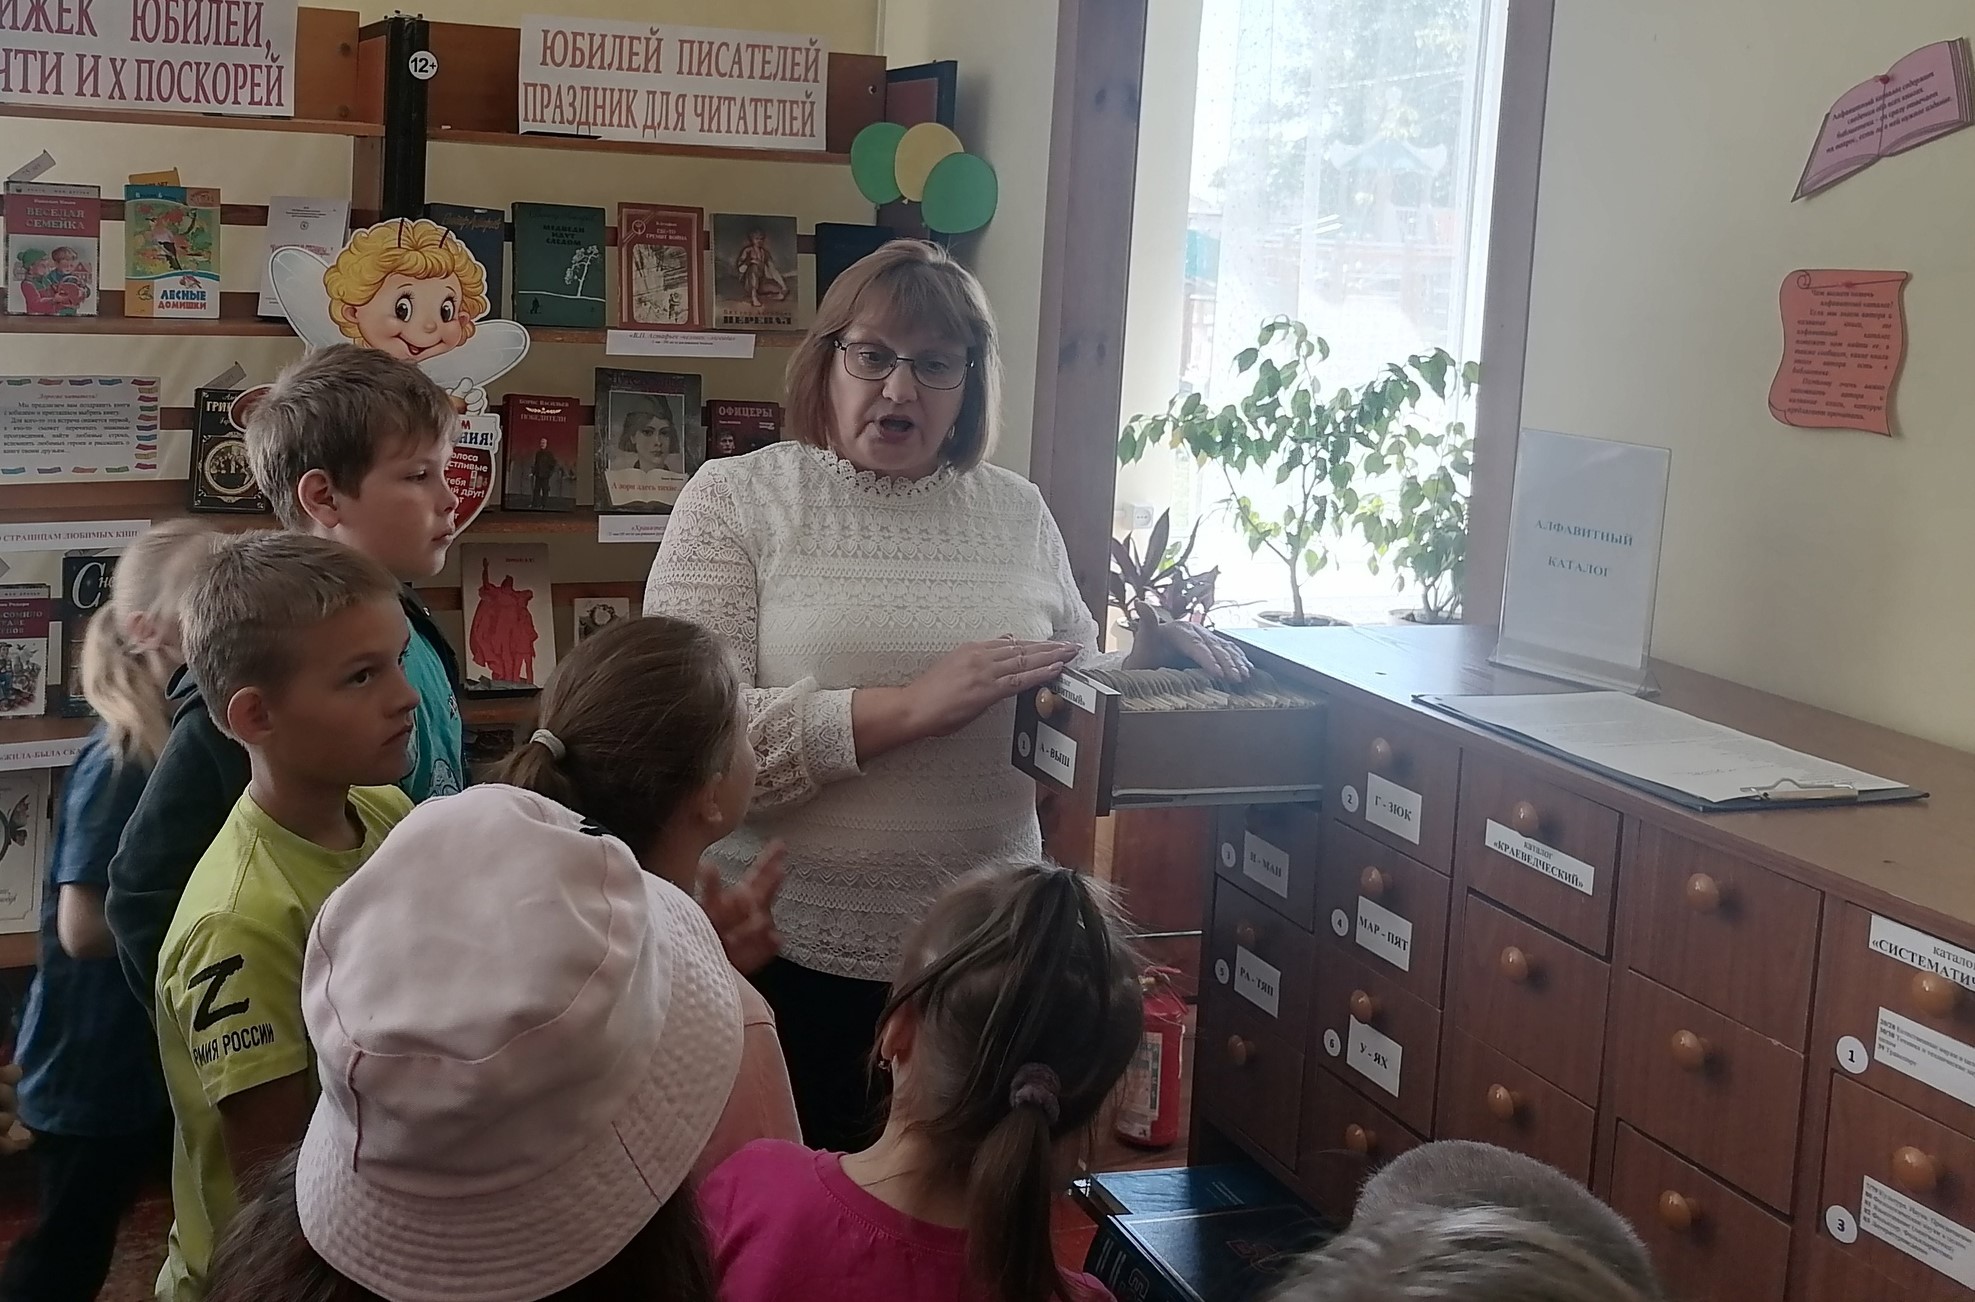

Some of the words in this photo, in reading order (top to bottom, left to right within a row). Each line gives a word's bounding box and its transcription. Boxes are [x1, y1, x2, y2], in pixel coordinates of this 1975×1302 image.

[0, 0, 98, 37] ИЖЕК
[540, 27, 662, 75] ЮБИЛЕЙ
[677, 37, 820, 85] ПИСАТЕЛЕЙ
[410, 57, 437, 73] 12+
[0, 48, 64, 96] ЧТИ
[135, 54, 285, 107] ПОСКОРЕЙ
[522, 82, 638, 135] ПРАЗДНИК
[642, 88, 687, 140] ДЛЯ
[693, 91, 816, 138] ЧИТАТЕЛЕЙ
[161, 290, 206, 301] ЛЕСНЫЕ
[158, 301, 206, 310] ДОМИШКИ
[723, 316, 792, 325] ПЕРЕВАЛ
[719, 406, 773, 419] ОФИЦЕРЫ
[458, 431, 494, 446] НИЯ!
[449, 461, 488, 472] стливые
[4, 533, 61, 542] СТРАНИЦАМ
[63, 531, 113, 540] ЛЮБИМЫХ
[1534, 519, 1633, 546] АЛФАВИТНЫЙ
[1548, 556, 1609, 577] КАТАЛОГ
[63, 747, 80, 755] СКА
[1050, 748, 1070, 767] ВЫШ
[1347, 794, 1352, 804] 2
[1375, 795, 1382, 807] Г
[1389, 801, 1412, 821] ЗЮК
[1523, 841, 1553, 860] каталог
[1493, 840, 1584, 888] «КРАЕВЕДЧЕСКИЙ»
[1337, 919, 1342, 928] 4
[1359, 915, 1380, 934] МАР
[1387, 931, 1409, 952] ПЯТ
[1240, 966, 1250, 981] РА
[187, 954, 249, 1032] Z
[193, 1039, 219, 1067] РМИЯ
[222, 1023, 274, 1055] РОССИИ
[1329, 1039, 1335, 1048] 6
[1360, 1042, 1367, 1054] У
[1373, 1051, 1388, 1069] ЯХ
[1848, 1050, 1856, 1063] 1
[1837, 1218, 1845, 1232] 3
